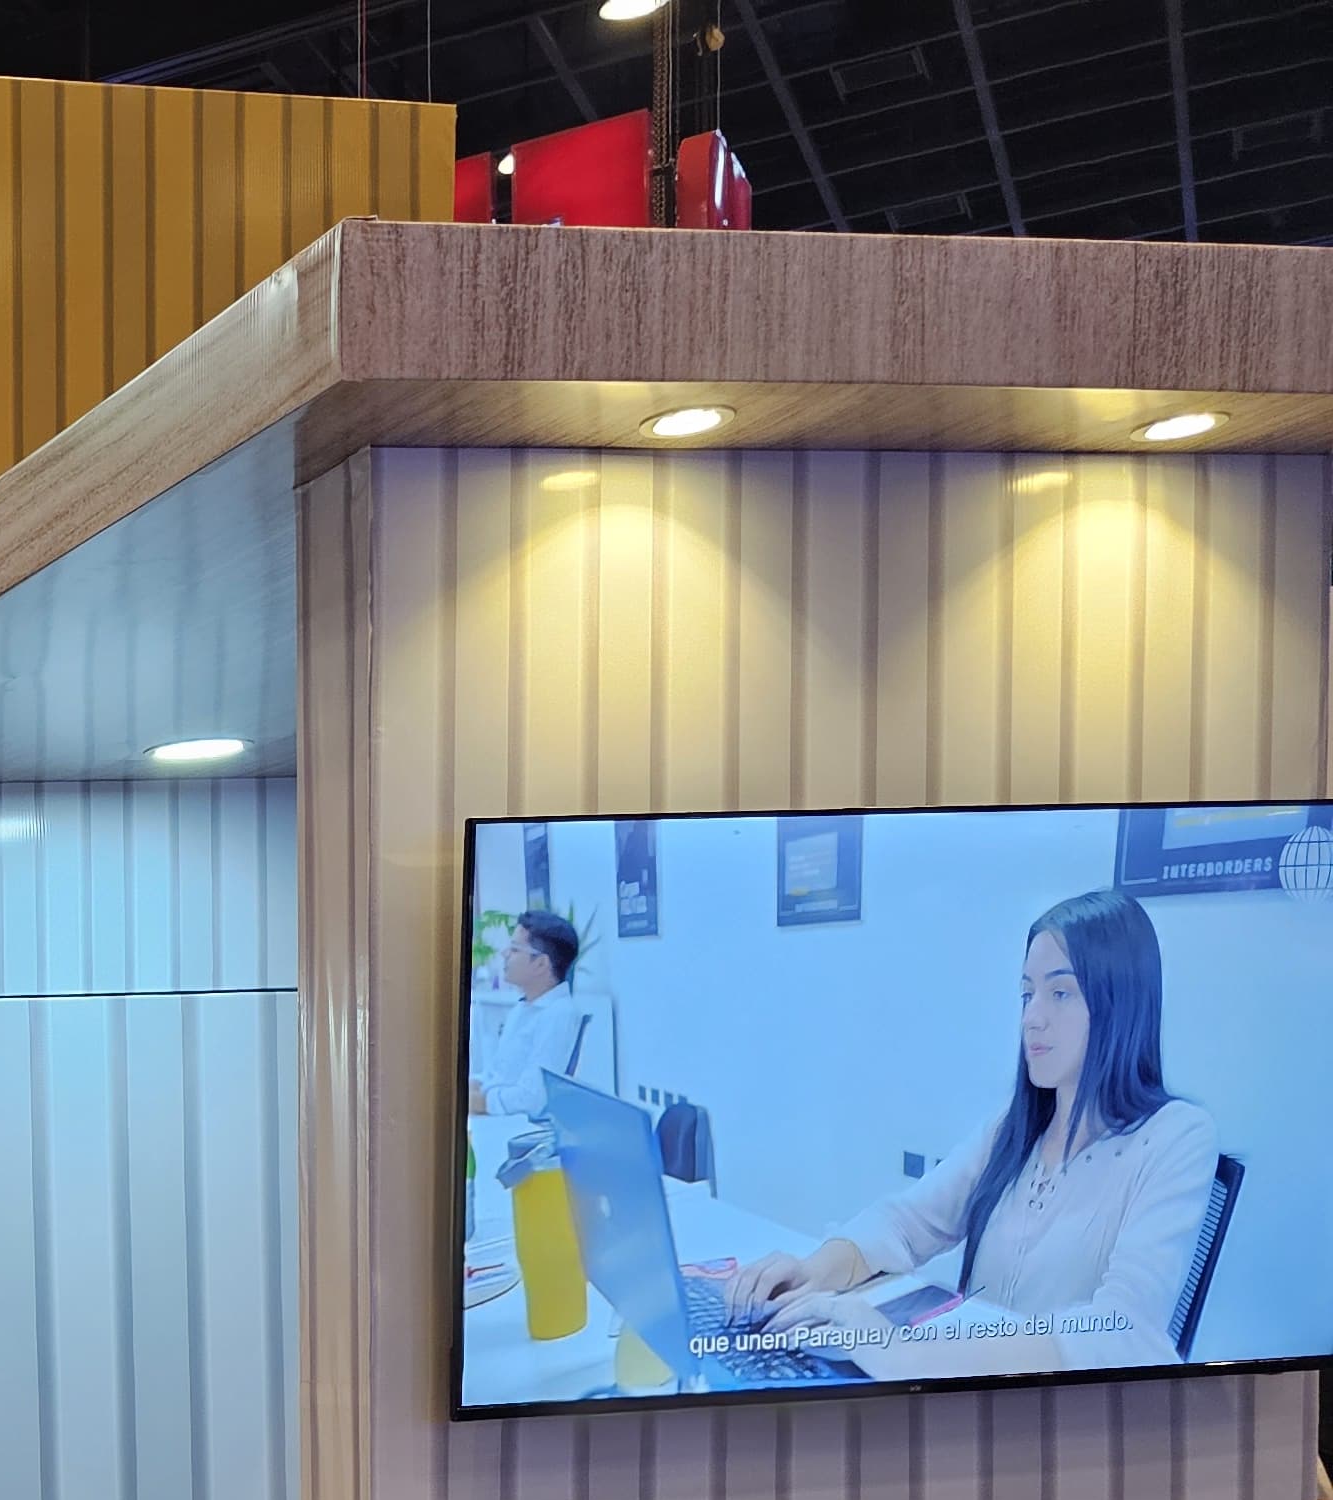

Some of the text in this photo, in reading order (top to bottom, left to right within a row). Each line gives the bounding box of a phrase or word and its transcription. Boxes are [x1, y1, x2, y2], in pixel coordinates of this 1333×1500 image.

[1162, 857, 1273, 880] INTERBORDERS
[690, 1310, 1134, 1359] que unen Paraguay con el resto del mundo.
